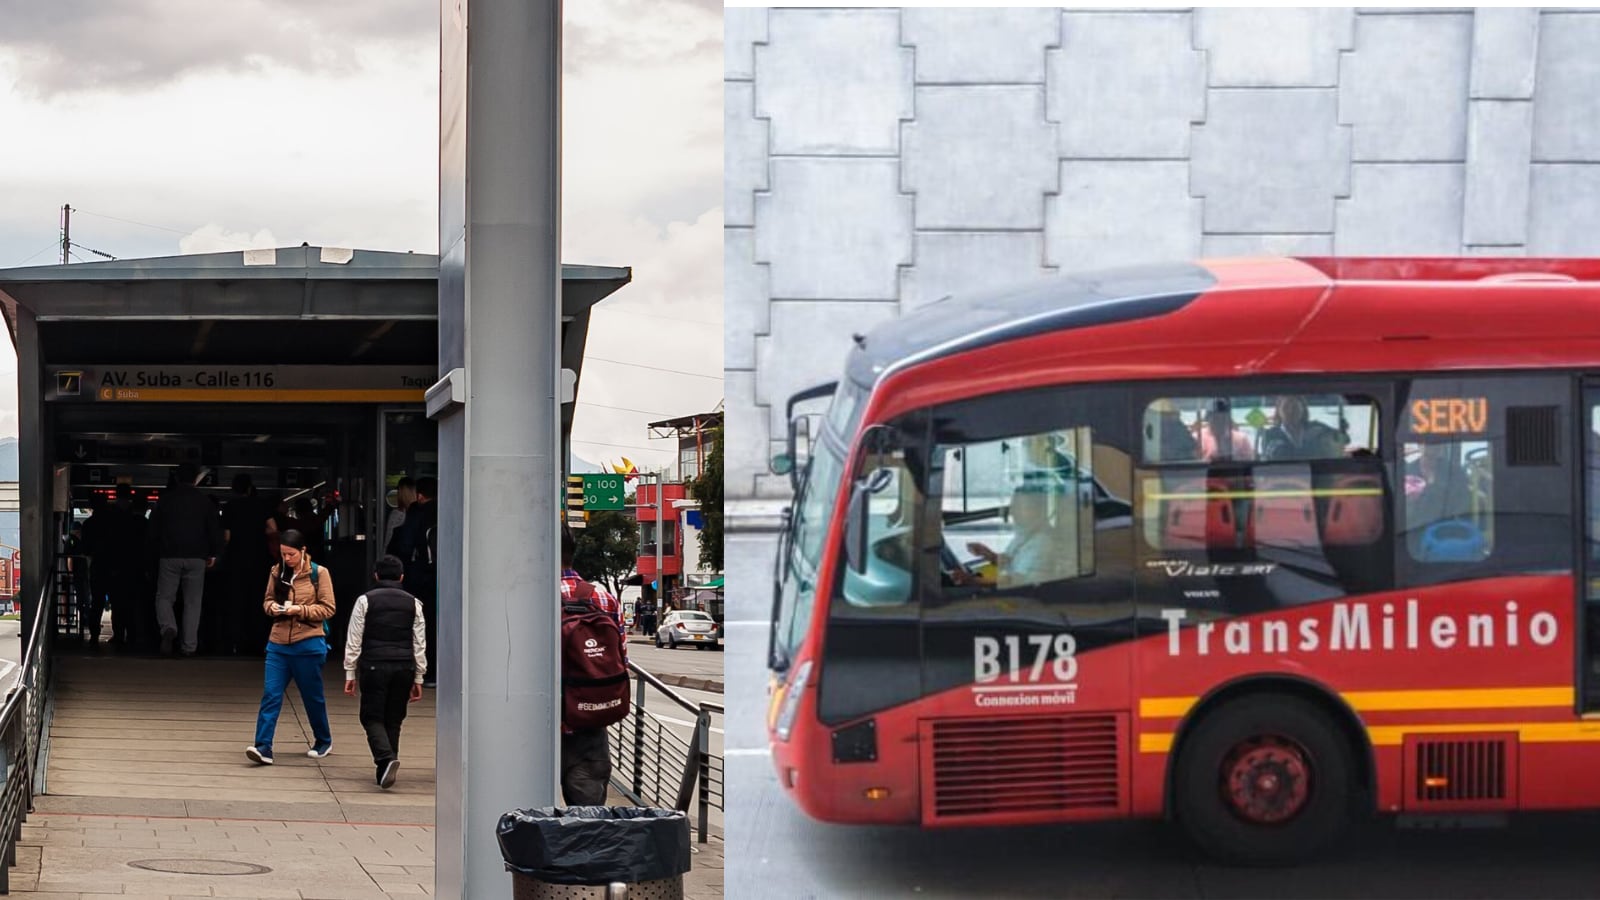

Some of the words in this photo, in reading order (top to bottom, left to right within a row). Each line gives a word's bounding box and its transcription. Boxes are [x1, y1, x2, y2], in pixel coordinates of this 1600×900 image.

[101, 372, 129, 387] AV.
[137, 371, 181, 387] Suba
[243, 372, 274, 387] 116
[401, 375, 438, 388] Taqui
[117, 390, 139, 398] Suba
[597, 480, 617, 489] 100
[1161, 600, 1558, 656] TransMilenio
[974, 633, 1078, 683] B178
